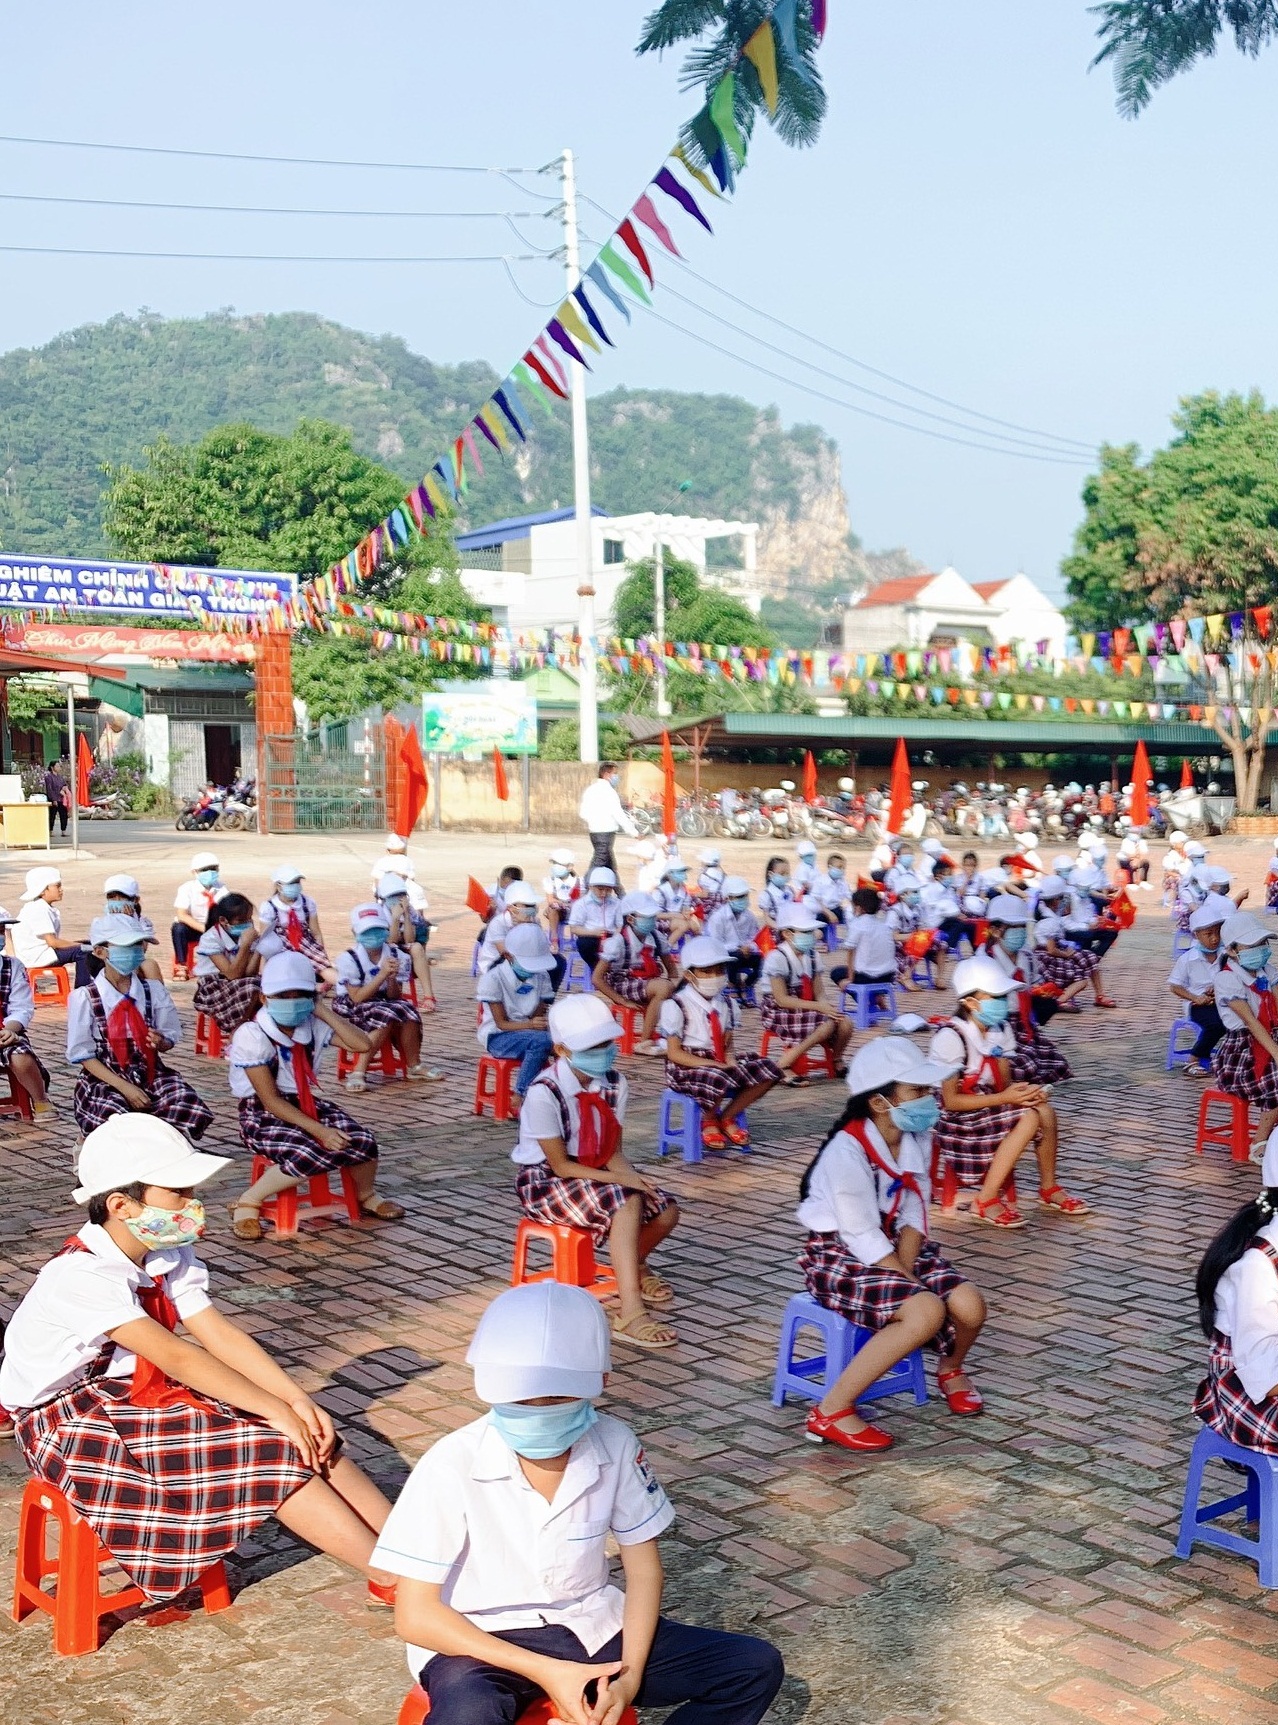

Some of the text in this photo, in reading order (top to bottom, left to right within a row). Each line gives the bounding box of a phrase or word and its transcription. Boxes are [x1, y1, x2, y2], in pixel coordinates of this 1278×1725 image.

[77, 567, 150, 589] CHỈNH
[44, 586, 77, 603] AN
[83, 587, 144, 607] TOÀN
[150, 592, 202, 610] GIAO
